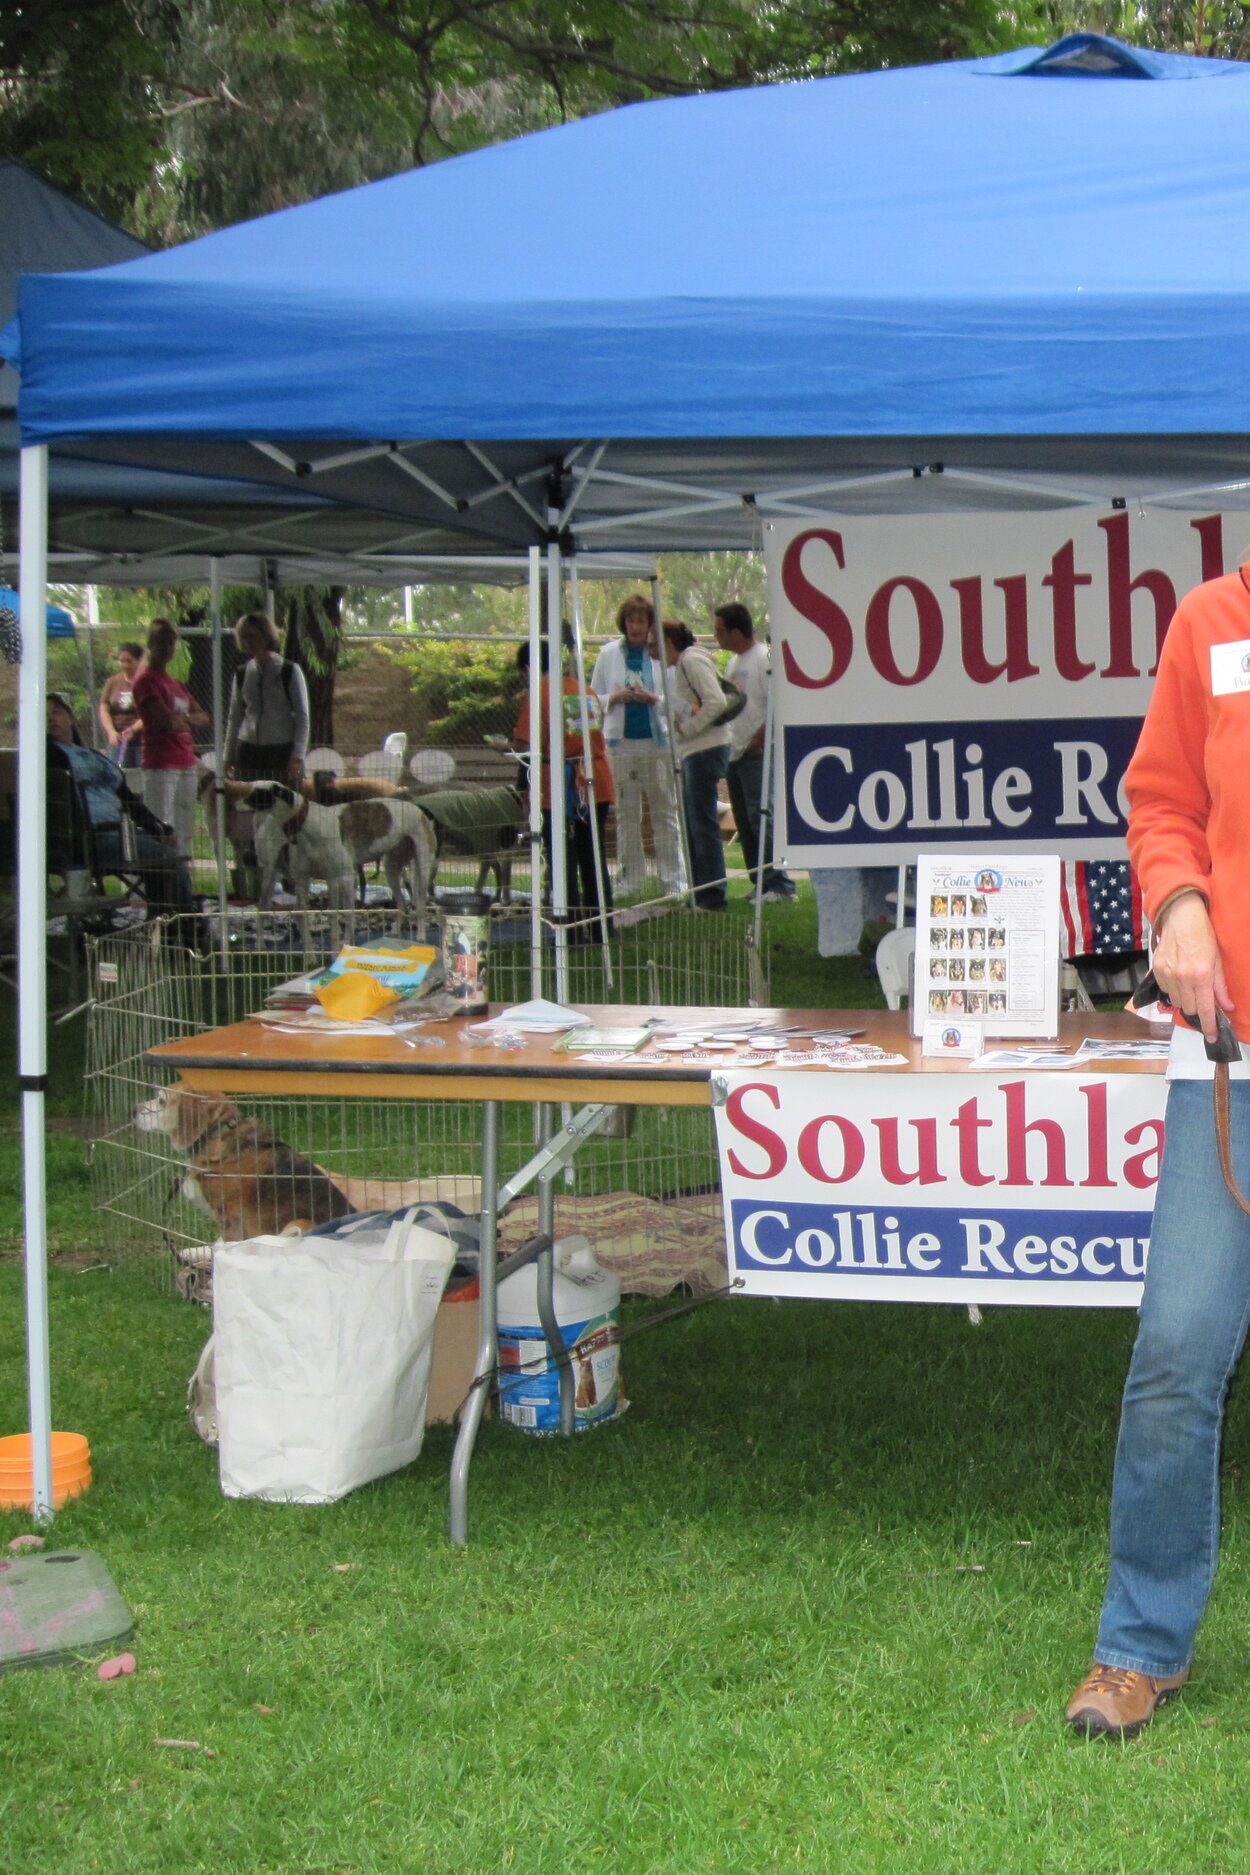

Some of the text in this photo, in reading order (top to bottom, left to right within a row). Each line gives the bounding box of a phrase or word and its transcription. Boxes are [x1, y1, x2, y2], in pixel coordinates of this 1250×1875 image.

[792, 738, 1033, 832] Collie
[942, 875, 1034, 887] Collie News
[739, 1209, 942, 1272] Collie
